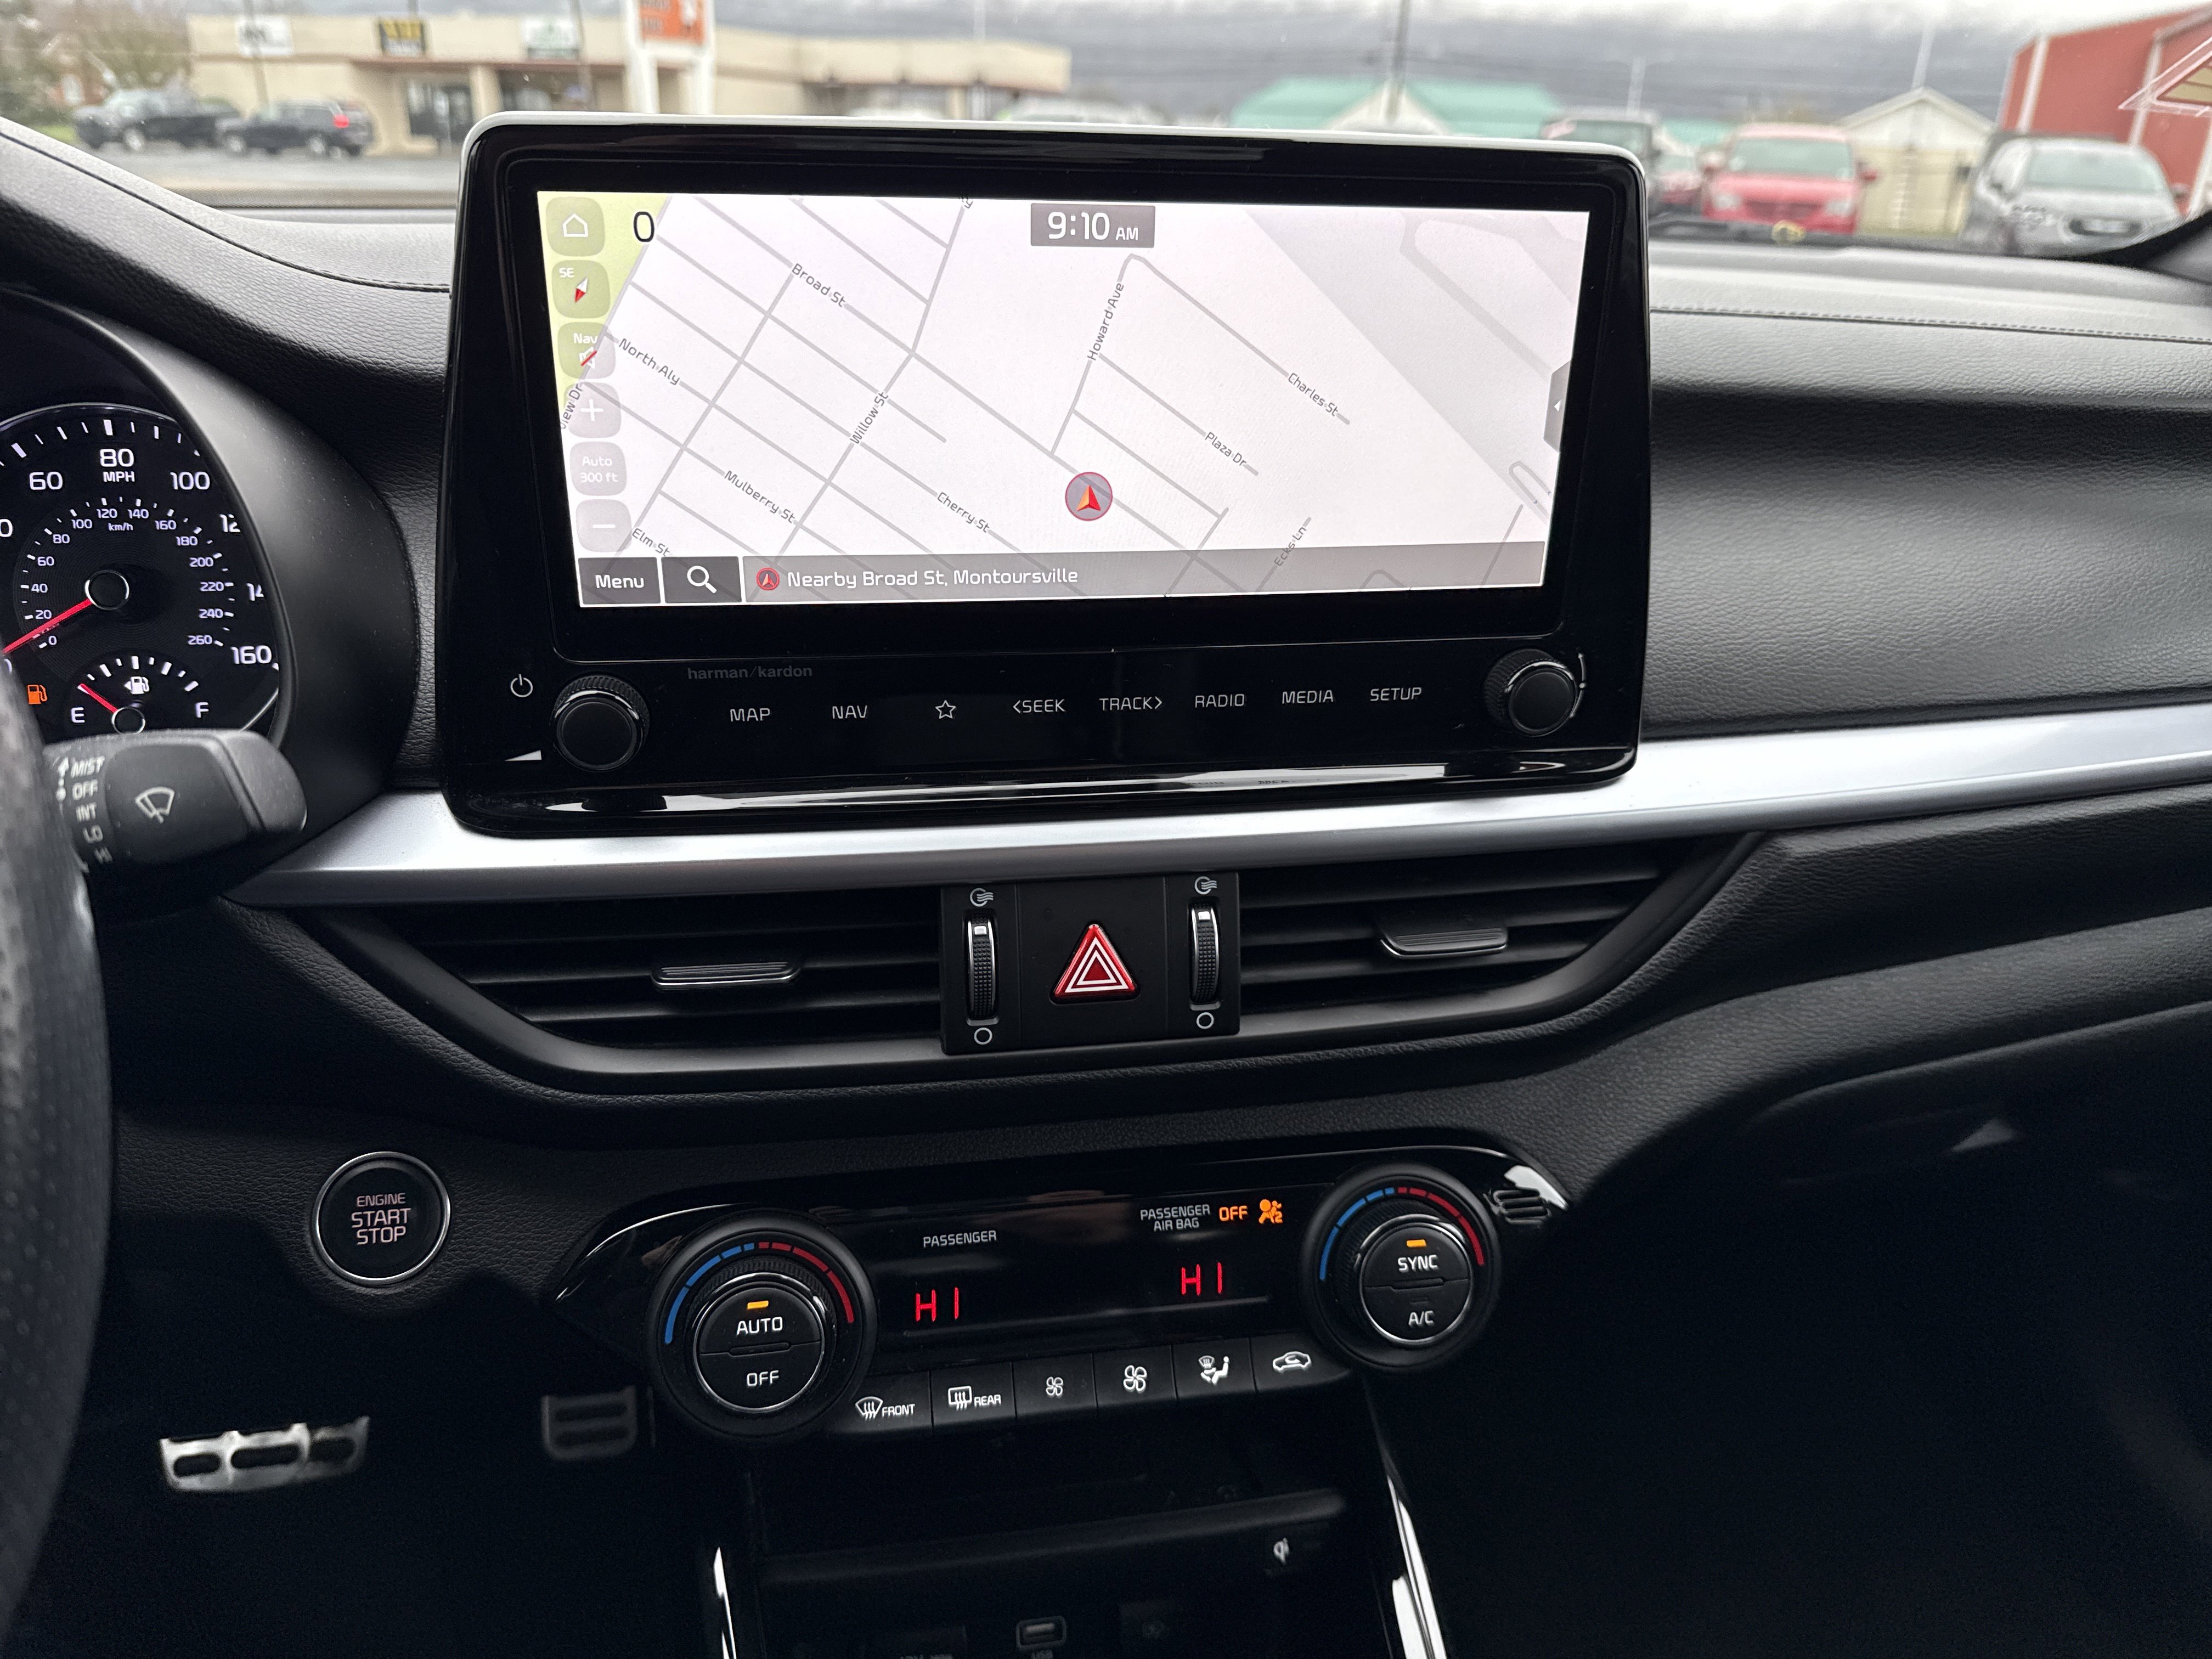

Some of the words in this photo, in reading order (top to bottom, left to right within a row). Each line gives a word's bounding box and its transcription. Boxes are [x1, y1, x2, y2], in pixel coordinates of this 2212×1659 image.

[634, 212, 654, 242] 0
[1048, 212, 1109, 240] 9:10
[1116, 227, 1138, 240] AM
[559, 268, 574, 278] SE
[792, 263, 831, 295] Broad
[831, 291, 845, 307] St
[1087, 309, 1113, 360] Howard
[1108, 283, 1124, 308] Ave
[573, 333, 597, 343] Nav
[619, 338, 657, 369] North
[658, 365, 680, 385] Aly
[569, 383, 583, 400] Dr
[1288, 373, 1325, 406] Charles
[1325, 402, 1338, 417] St
[850, 407, 878, 444] Willow
[874, 392, 888, 407] St
[1205, 432, 1232, 456] Plaza
[1233, 453, 1246, 466] Dr
[100, 449, 134, 467] 80
[582, 456, 612, 466] Auto
[30, 472, 63, 490] 60
[103, 471, 134, 482] MPH
[170, 472, 210, 489] 100
[580, 472, 602, 483] 300
[606, 472, 618, 483] ft
[724, 471, 779, 514] Mulberry
[781, 509, 795, 523] St
[97, 509, 117, 518] 120
[128, 509, 149, 518] 140
[938, 492, 975, 524] Cherry
[977, 519, 989, 533] St
[71, 519, 92, 528] 100
[109, 522, 133, 531] km/h
[155, 520, 176, 529] 160
[53, 534, 70, 543] 80
[176, 536, 198, 545] 180
[632, 528, 653, 547] Elm
[655, 543, 670, 556] St
[1274, 542, 1295, 566] Ecks
[1292, 527, 1307, 540] Ln
[38, 556, 54, 566] 60
[190, 557, 213, 567] 200
[595, 575, 644, 588] Menu
[788, 572, 856, 588] Nearby
[863, 571, 917, 585] Broad
[924, 571, 947, 586] St,
[954, 568, 1077, 584] Montoursville
[31, 584, 48, 592] 40
[200, 582, 224, 591] 220
[35, 610, 52, 619] 20
[199, 608, 223, 618] 240
[48, 635, 57, 645] 0
[188, 635, 212, 645] 260
[231, 645, 272, 664] 160
[688, 666, 812, 679] harman/kardon
[1195, 694, 1244, 708] RADIO
[1282, 690, 1333, 704] MEDIA
[1370, 687, 1421, 701] SETUP
[71, 707, 84, 723] E
[196, 702, 208, 718] F
[730, 708, 770, 721] MAP
[832, 706, 867, 719] NAV
[71, 756, 105, 778] MIST
[72, 780, 98, 800] OFF
[76, 802, 97, 822] INT
[83, 825, 103, 843] LO
[357, 1193, 405, 1207] ENGINE
[351, 1208, 411, 1228] START
[1141, 1204, 1210, 1220] PASSENGER
[1219, 1206, 1247, 1221] OFF
[1154, 1220, 1173, 1232] AIR
[1177, 1217, 1199, 1230] BAG
[357, 1226, 406, 1245] STOP
[923, 1231, 996, 1248] PASSENGER
[1398, 1255, 1437, 1271] SYNC
[1409, 1311, 1433, 1325] A/C
[737, 1317, 782, 1335] AUTO
[747, 1370, 778, 1386] OFF
[974, 1395, 1001, 1407] REAR
[882, 1404, 915, 1417] FRONT
